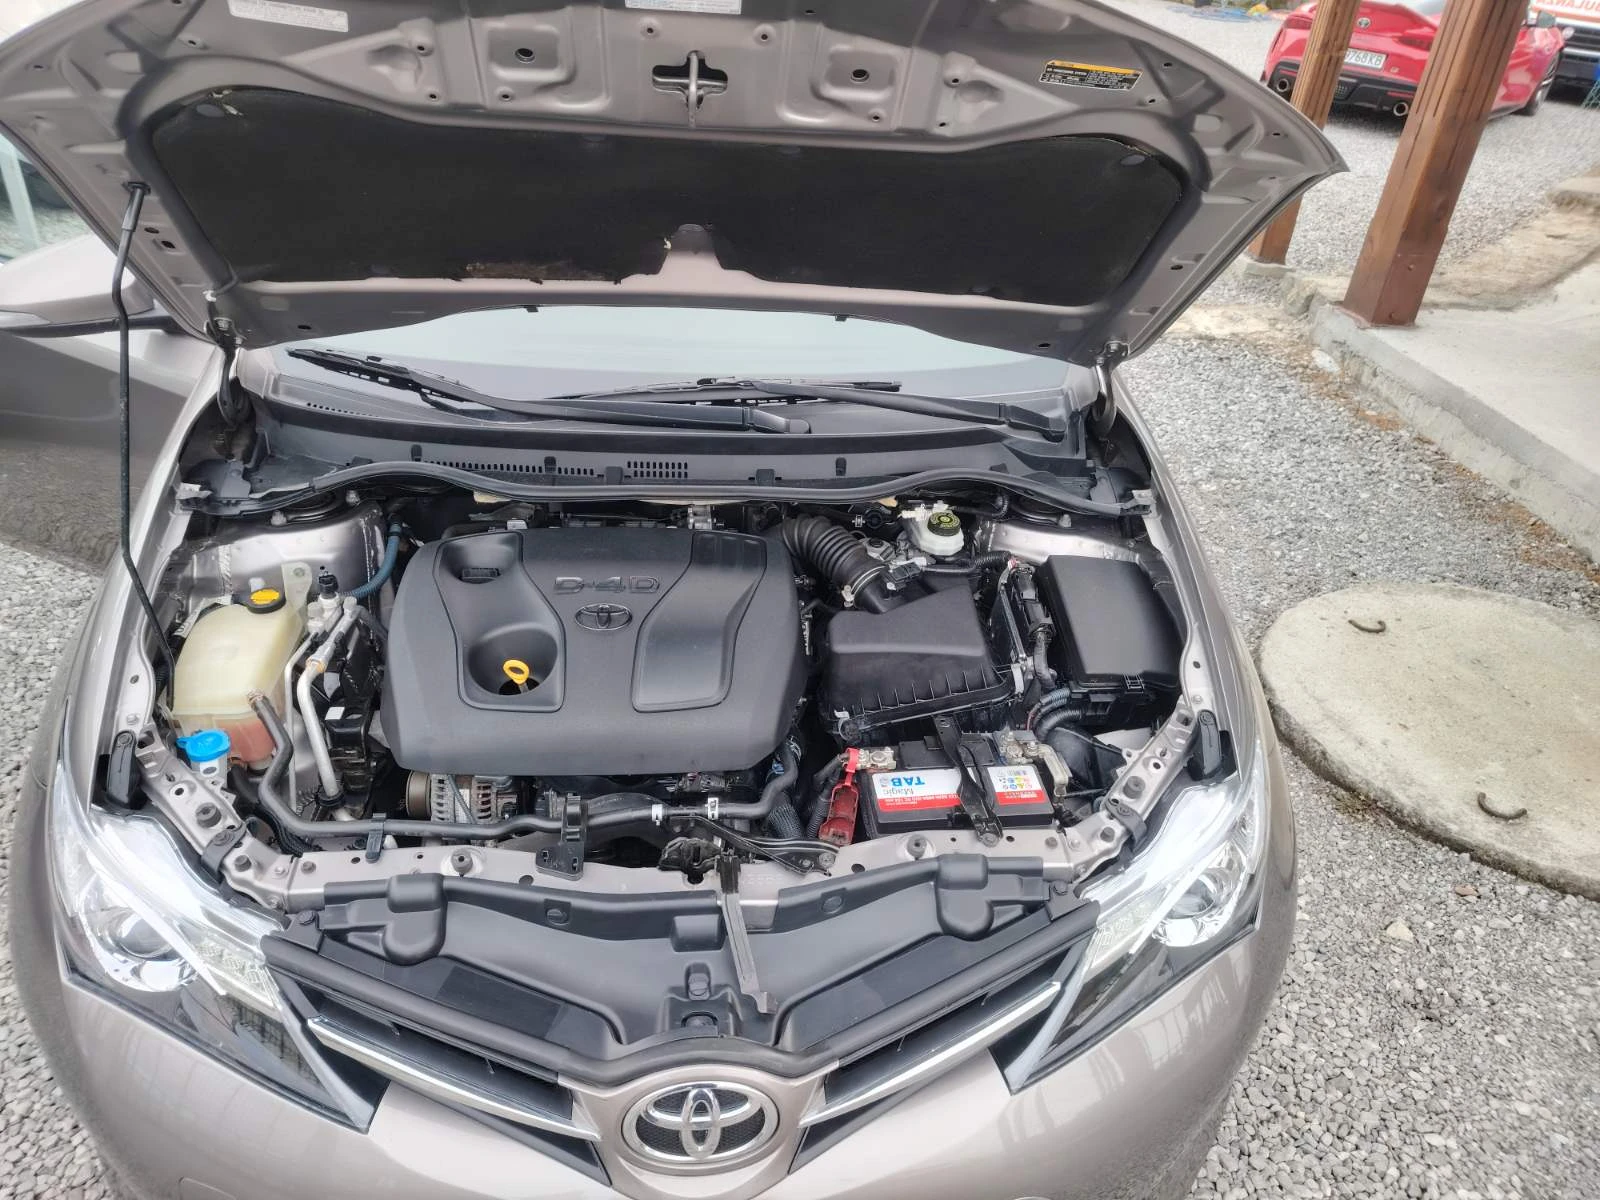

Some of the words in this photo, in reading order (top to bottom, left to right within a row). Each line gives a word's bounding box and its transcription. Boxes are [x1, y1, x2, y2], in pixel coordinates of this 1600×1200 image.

[553, 576, 660, 594] D-4D
[891, 776, 925, 786] TAB
[882, 787, 914, 796] Magic
